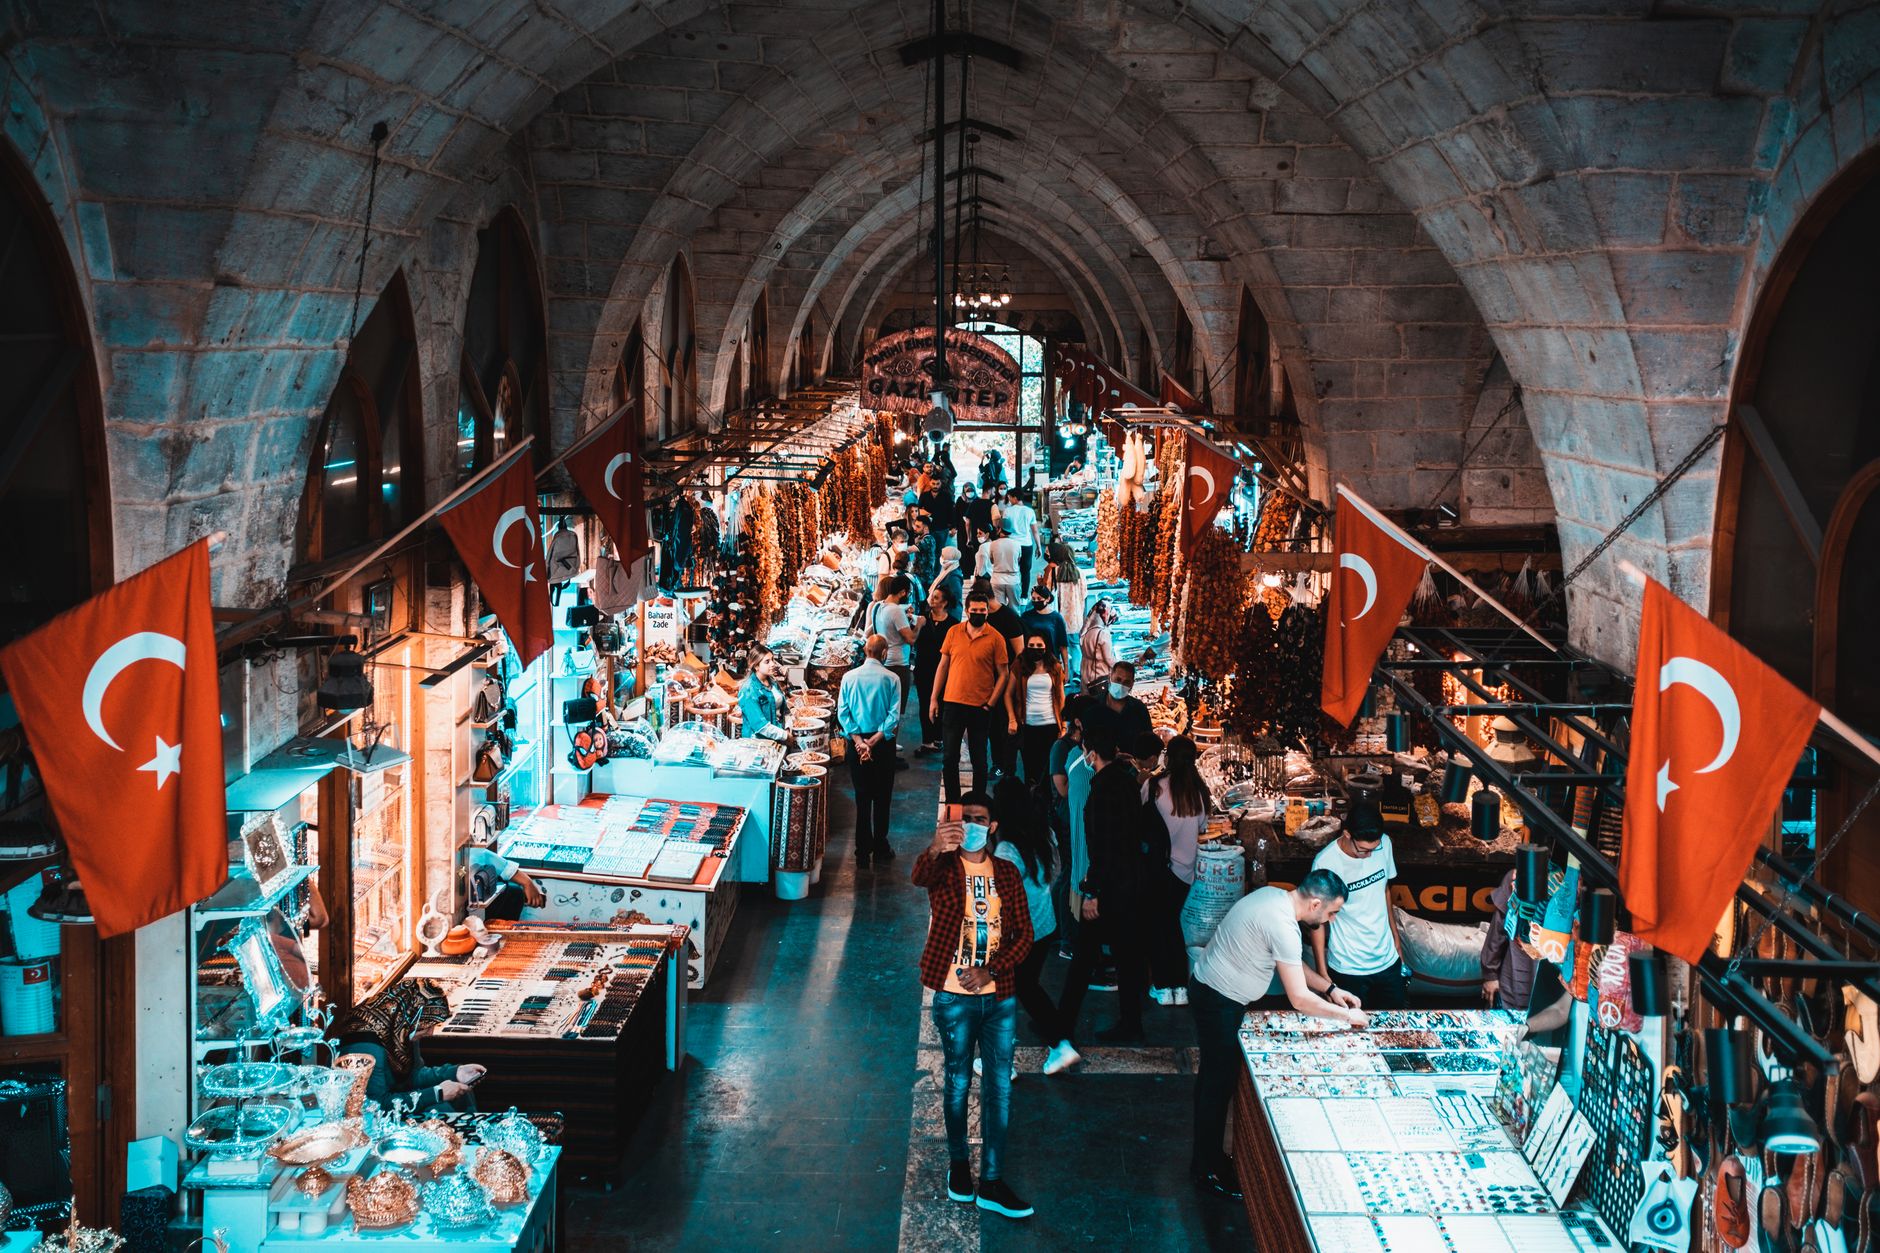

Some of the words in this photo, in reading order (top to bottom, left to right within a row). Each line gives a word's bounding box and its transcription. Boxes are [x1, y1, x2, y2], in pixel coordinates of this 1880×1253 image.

[648, 611, 673, 619] Baharat
[653, 620, 669, 628] Zade
[1348, 870, 1386, 891] JACK&JONES
